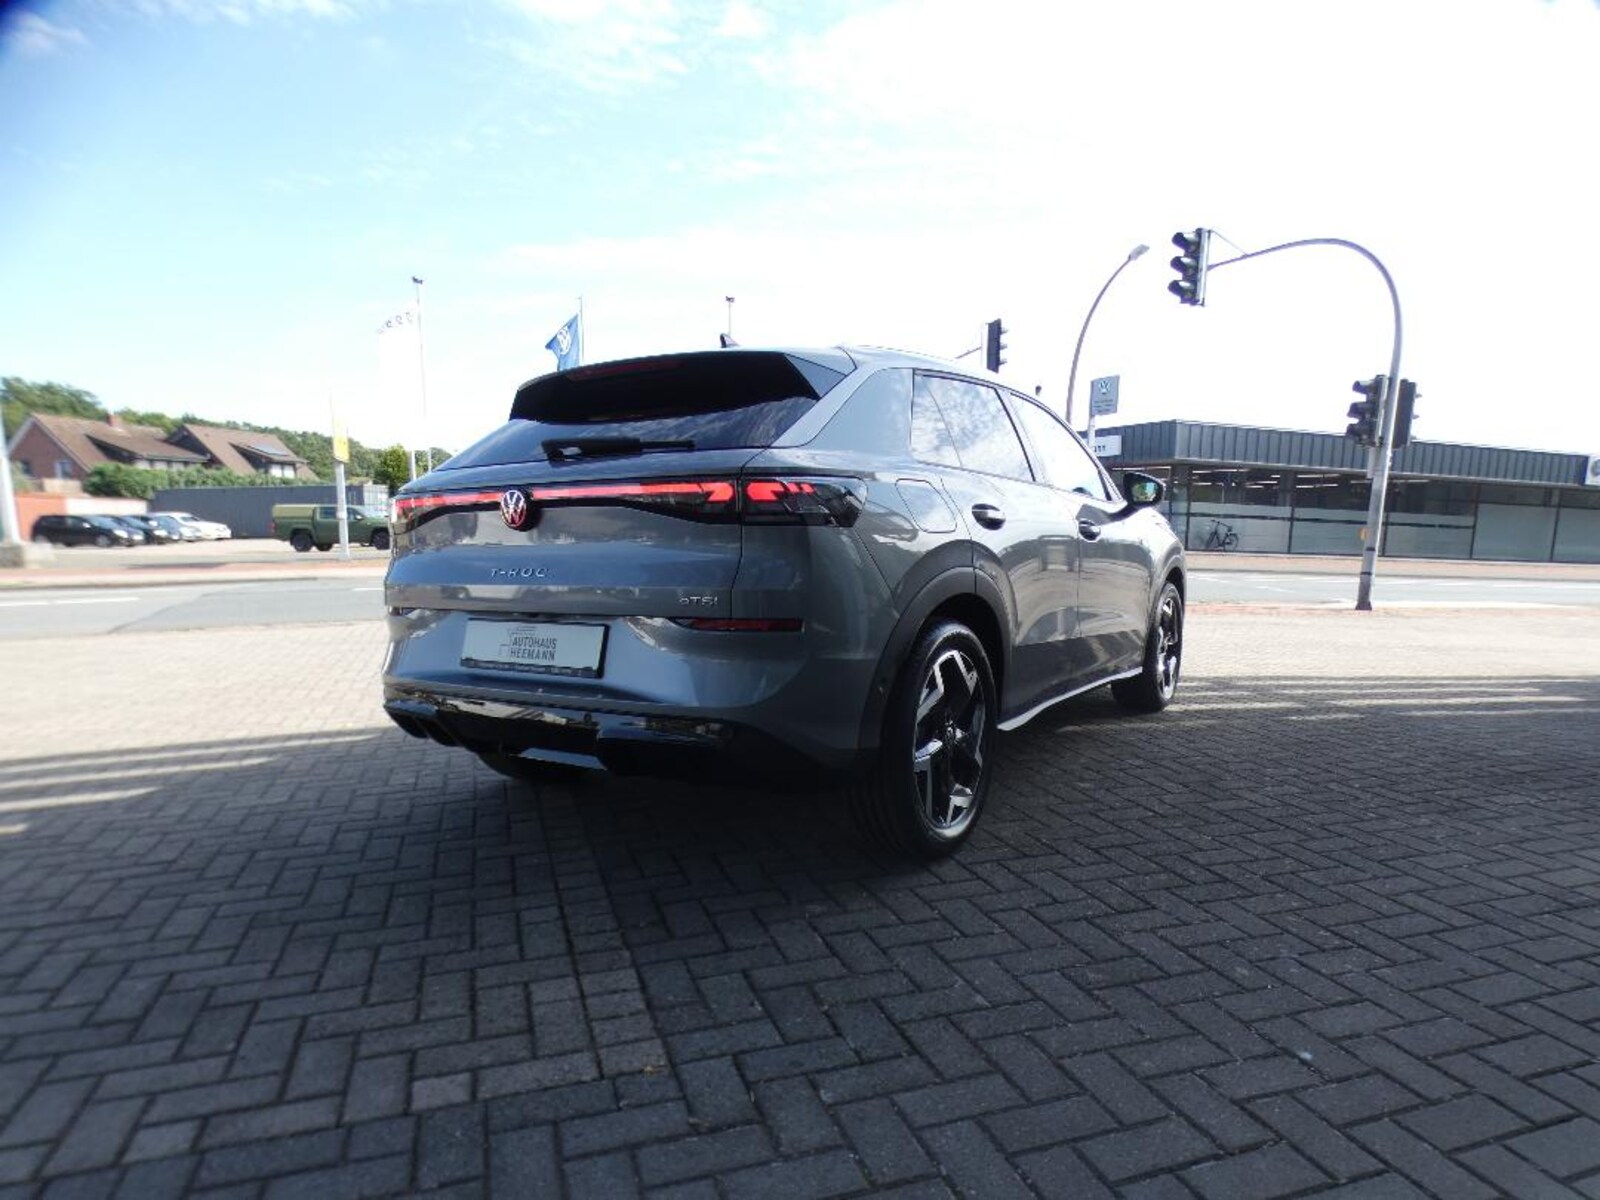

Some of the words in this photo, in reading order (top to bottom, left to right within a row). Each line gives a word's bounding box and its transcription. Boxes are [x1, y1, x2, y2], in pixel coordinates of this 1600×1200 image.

[491, 567, 548, 578] T-ROC
[512, 636, 558, 650] AUTOHAUS
[510, 648, 556, 661] HEEMANN
